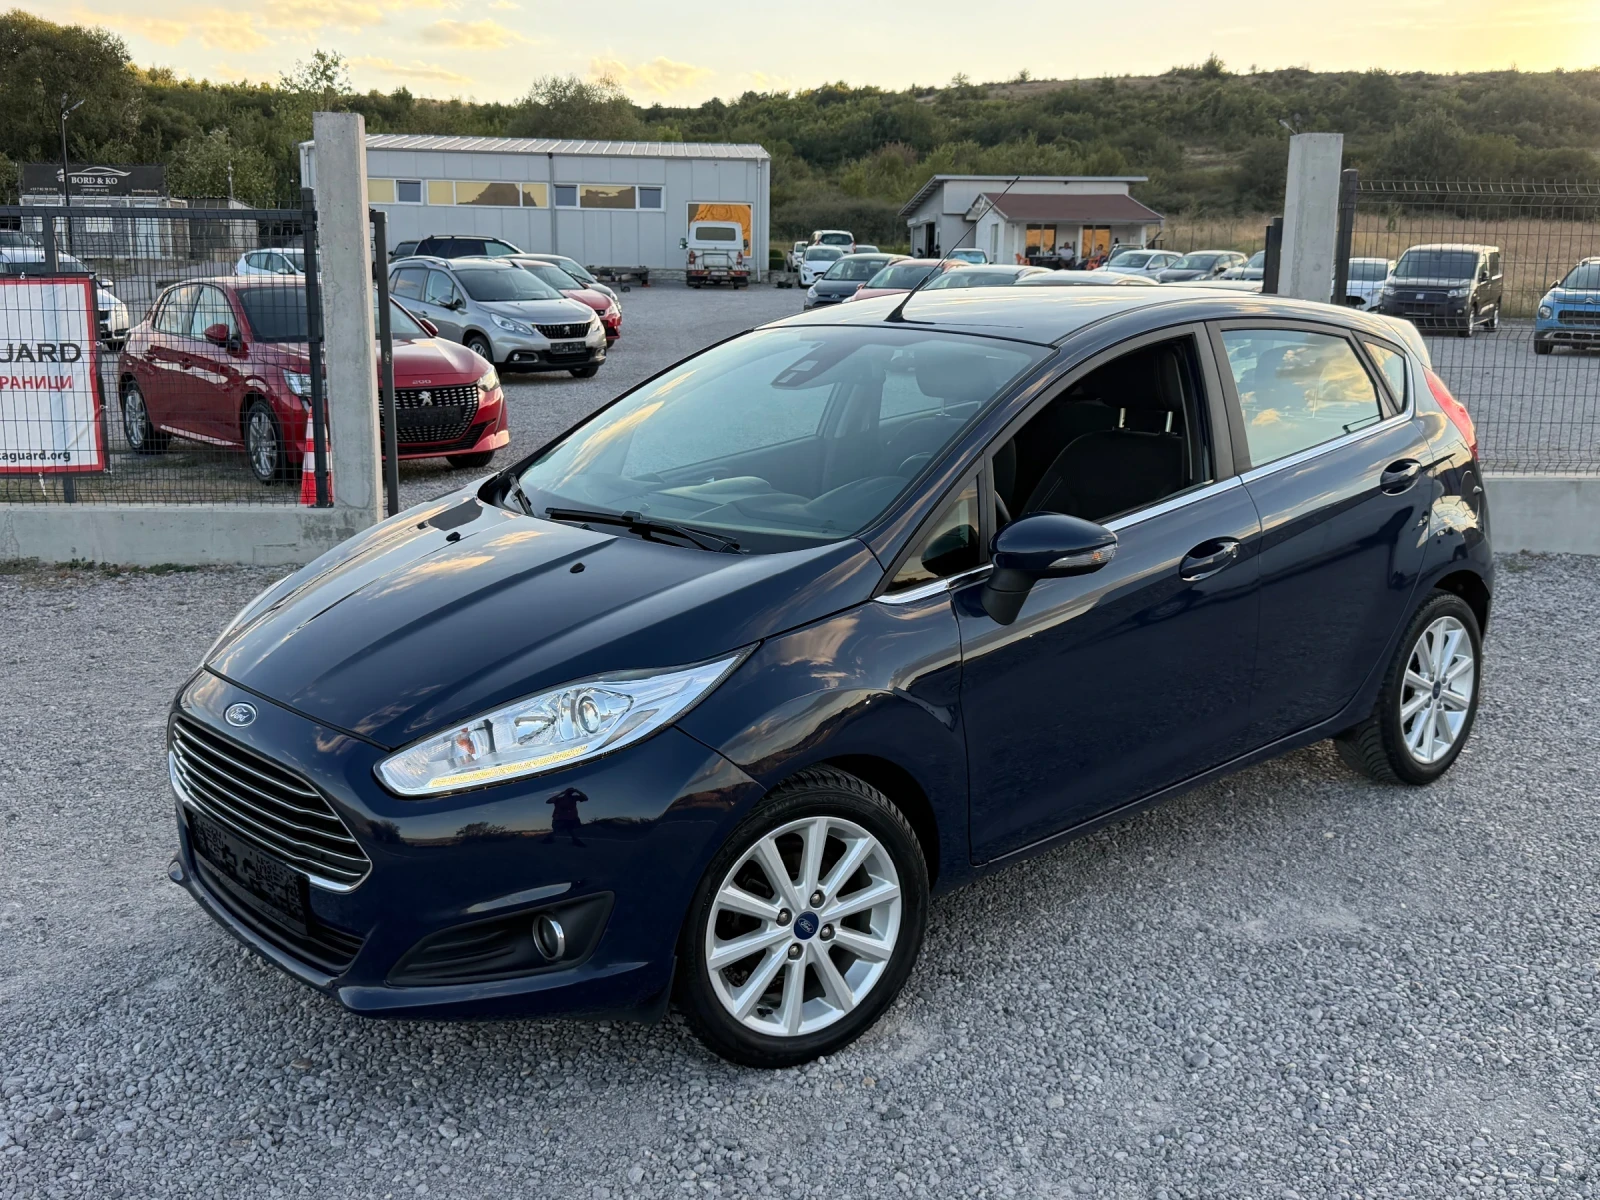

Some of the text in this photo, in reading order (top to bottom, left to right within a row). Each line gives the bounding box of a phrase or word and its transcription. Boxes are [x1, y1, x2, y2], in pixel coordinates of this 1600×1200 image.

[71, 177, 118, 185] BORD & KO
[0, 376, 72, 392] РАНИЦИ
[0, 450, 71, 462] aguard.org
